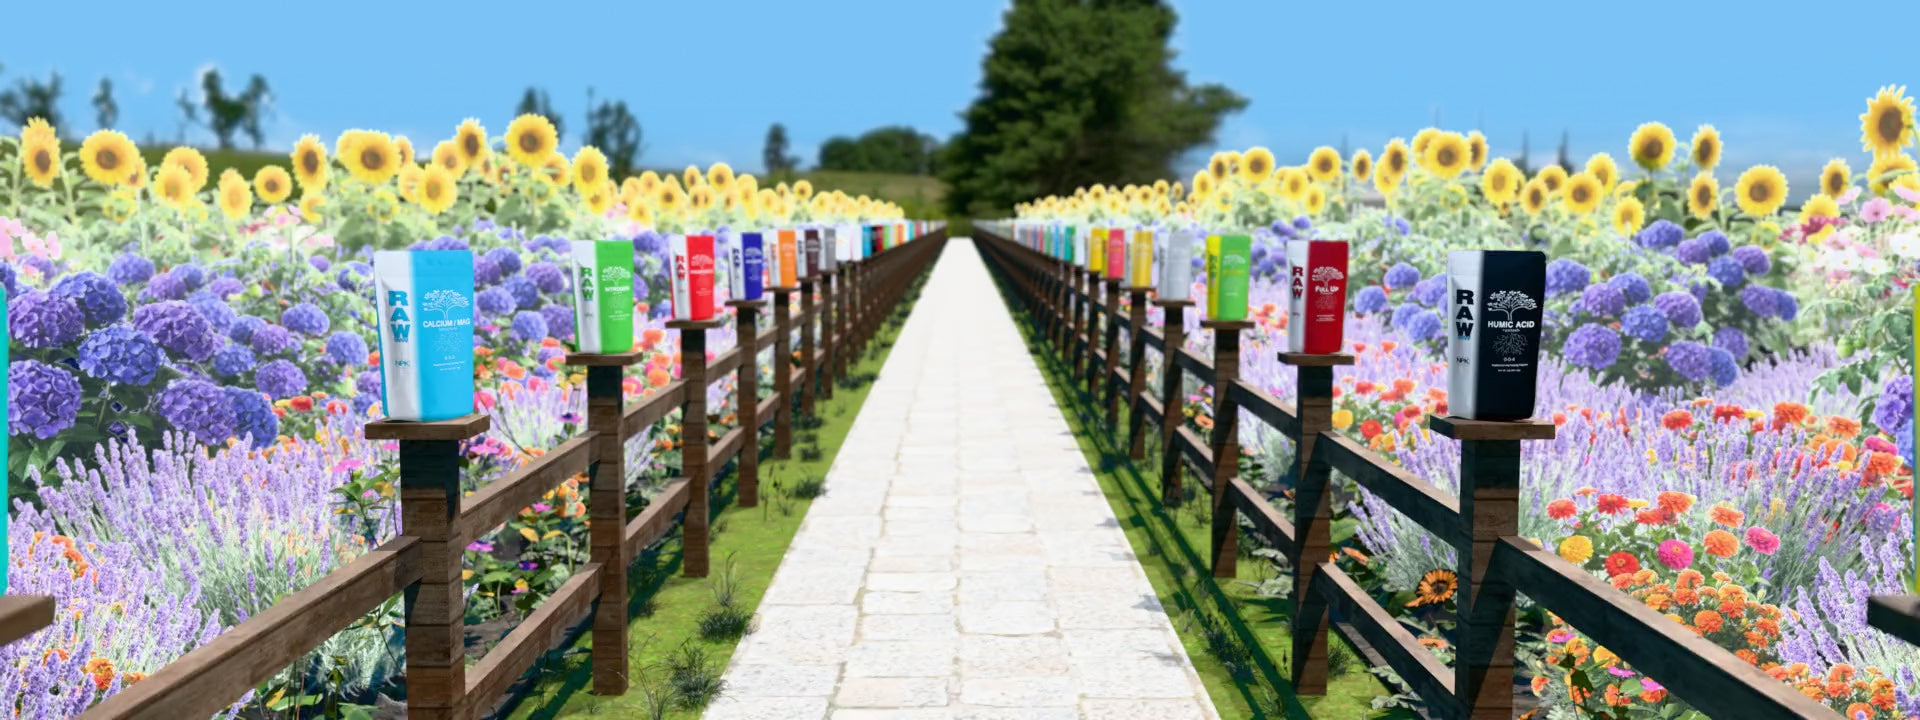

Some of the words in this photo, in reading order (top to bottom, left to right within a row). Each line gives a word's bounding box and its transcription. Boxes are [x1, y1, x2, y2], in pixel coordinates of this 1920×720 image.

[580, 267, 594, 300] RAW
[1292, 266, 1304, 299] RAW
[388, 290, 411, 339] RAW
[423, 320, 453, 328] CALCIUM
[457, 318, 470, 326] MAG
[1456, 289, 1474, 337] RAW
[1487, 320, 1514, 328] HUMIC
[1515, 320, 1535, 328] ACID
